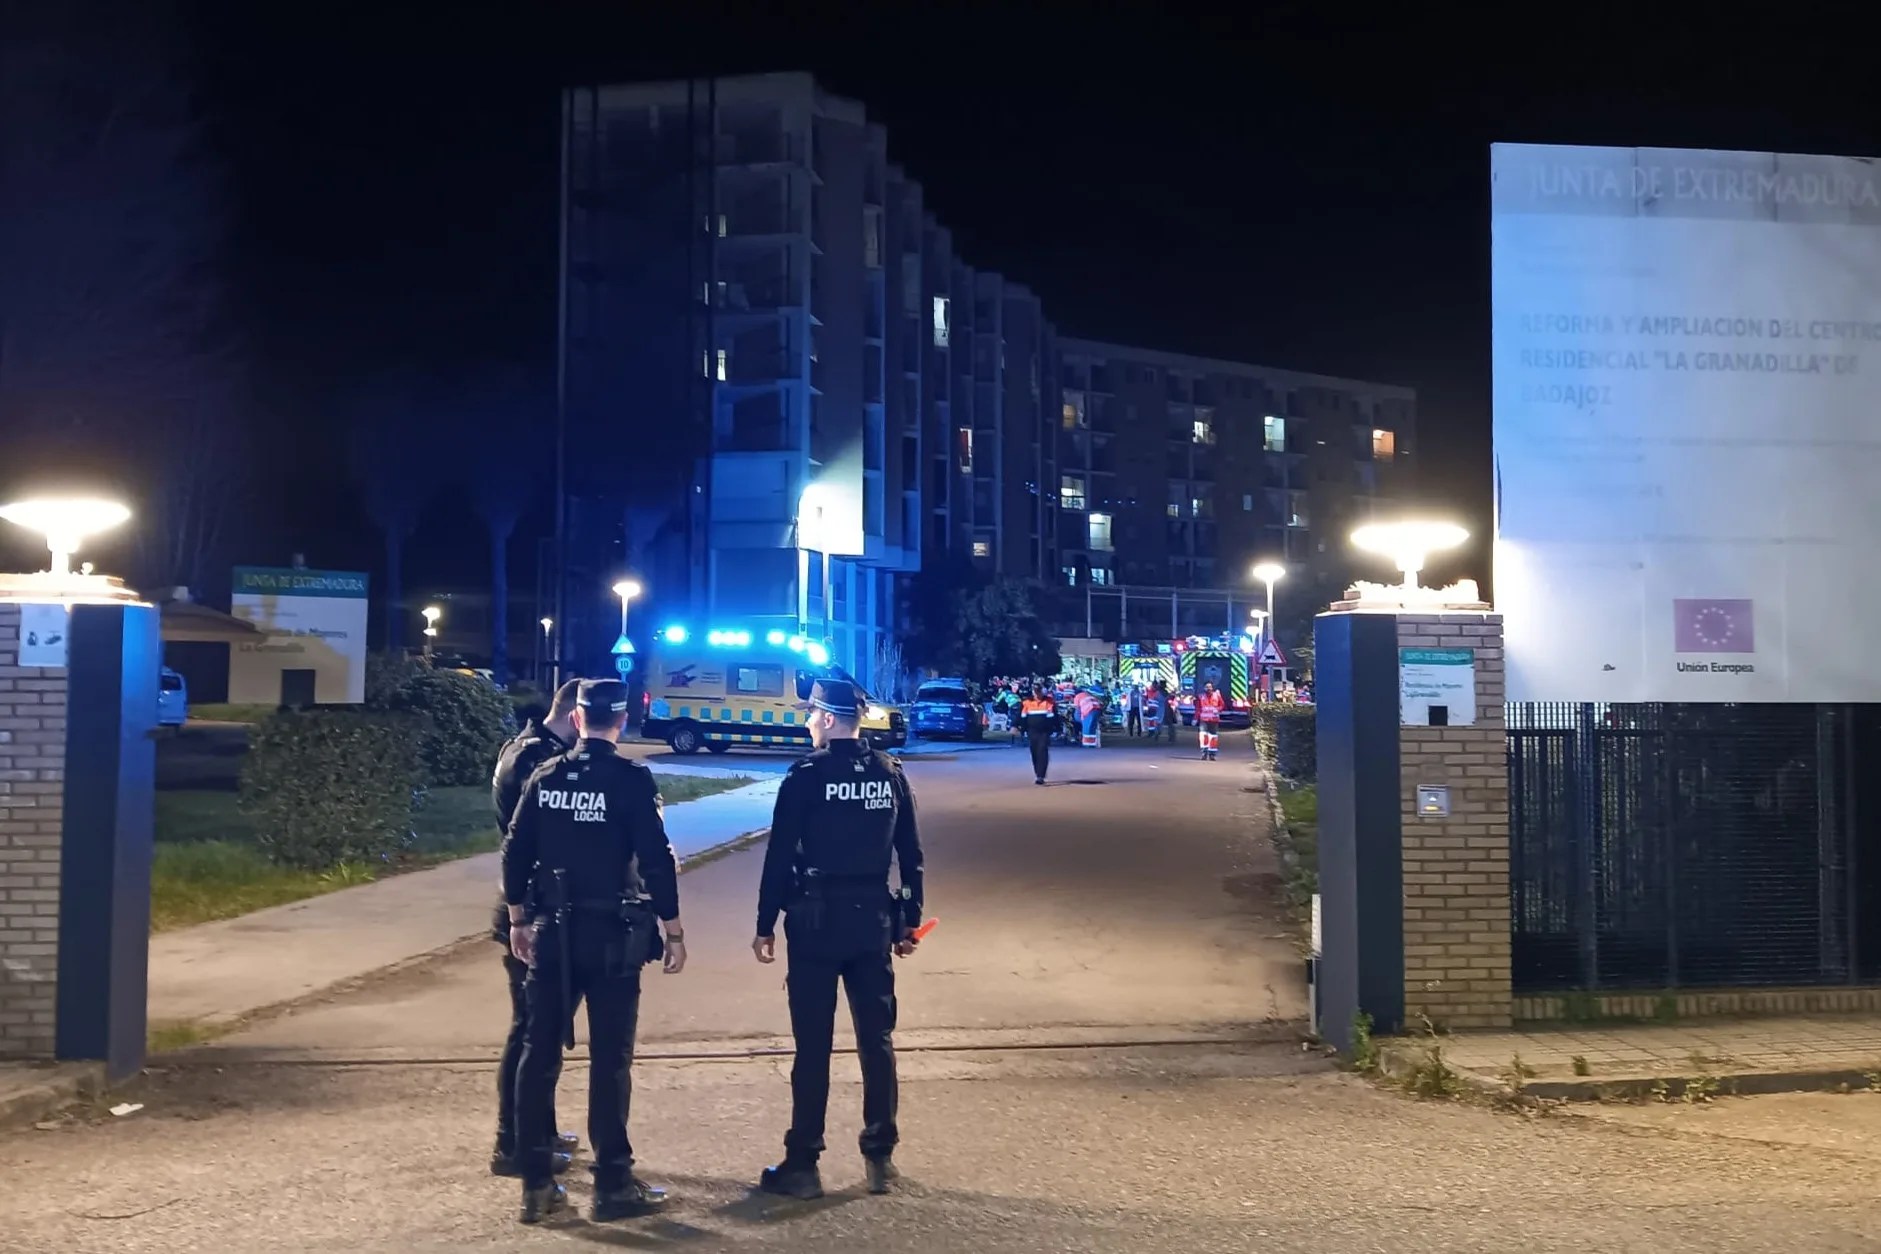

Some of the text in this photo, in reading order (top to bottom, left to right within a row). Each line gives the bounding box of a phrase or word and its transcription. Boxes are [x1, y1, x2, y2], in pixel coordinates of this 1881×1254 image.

[1529, 162, 1880, 207] JUNTA DE EXTREMADURA
[1520, 313, 1614, 335] REFORMA
[1621, 315, 1635, 335] Y
[1768, 318, 1803, 340] DEL
[1520, 348, 1650, 371] RESIDENCIAL
[1520, 383, 1613, 409] BADAJOZ
[620, 659, 630, 669] 10
[1676, 660, 1755, 676] Unión Europea
[539, 790, 606, 811] POLICIA
[825, 781, 893, 801] POLICIA
[864, 798, 893, 810] LOCAL
[573, 810, 606, 822] LOCAL
